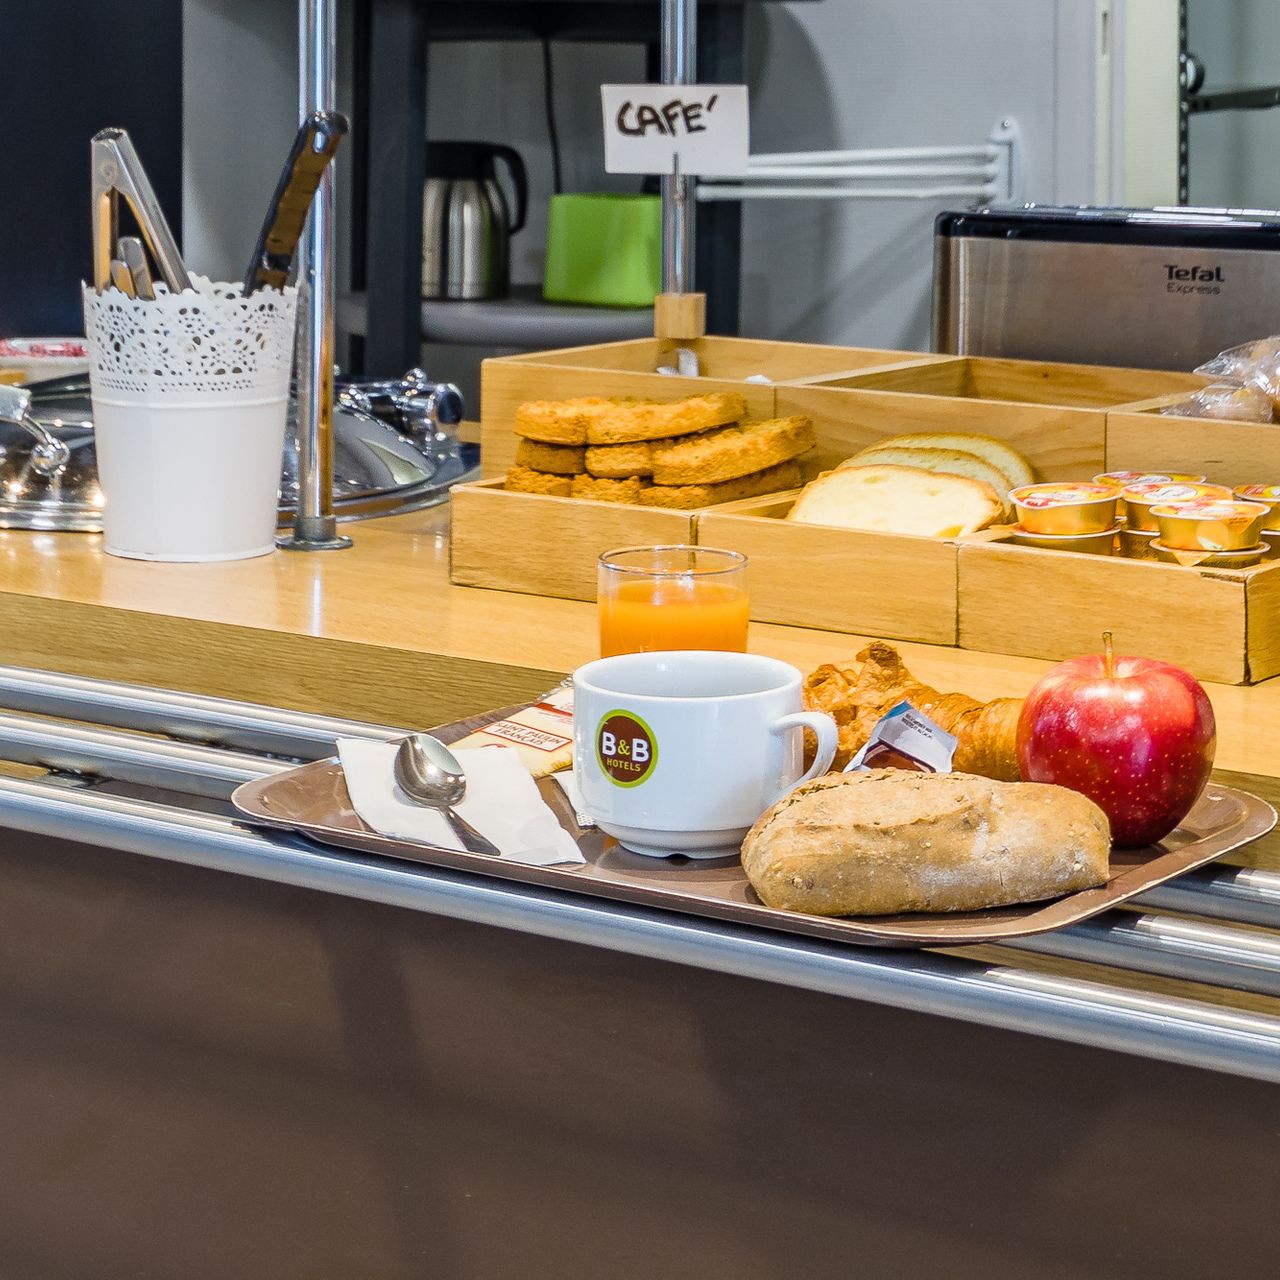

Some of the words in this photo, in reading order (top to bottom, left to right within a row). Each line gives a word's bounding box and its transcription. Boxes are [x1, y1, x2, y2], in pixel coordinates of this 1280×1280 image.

[1163, 265, 1225, 282] Tefal
[1166, 282, 1221, 296] Express
[602, 731, 650, 762] B&B
[606, 758, 641, 772] HOTELS
